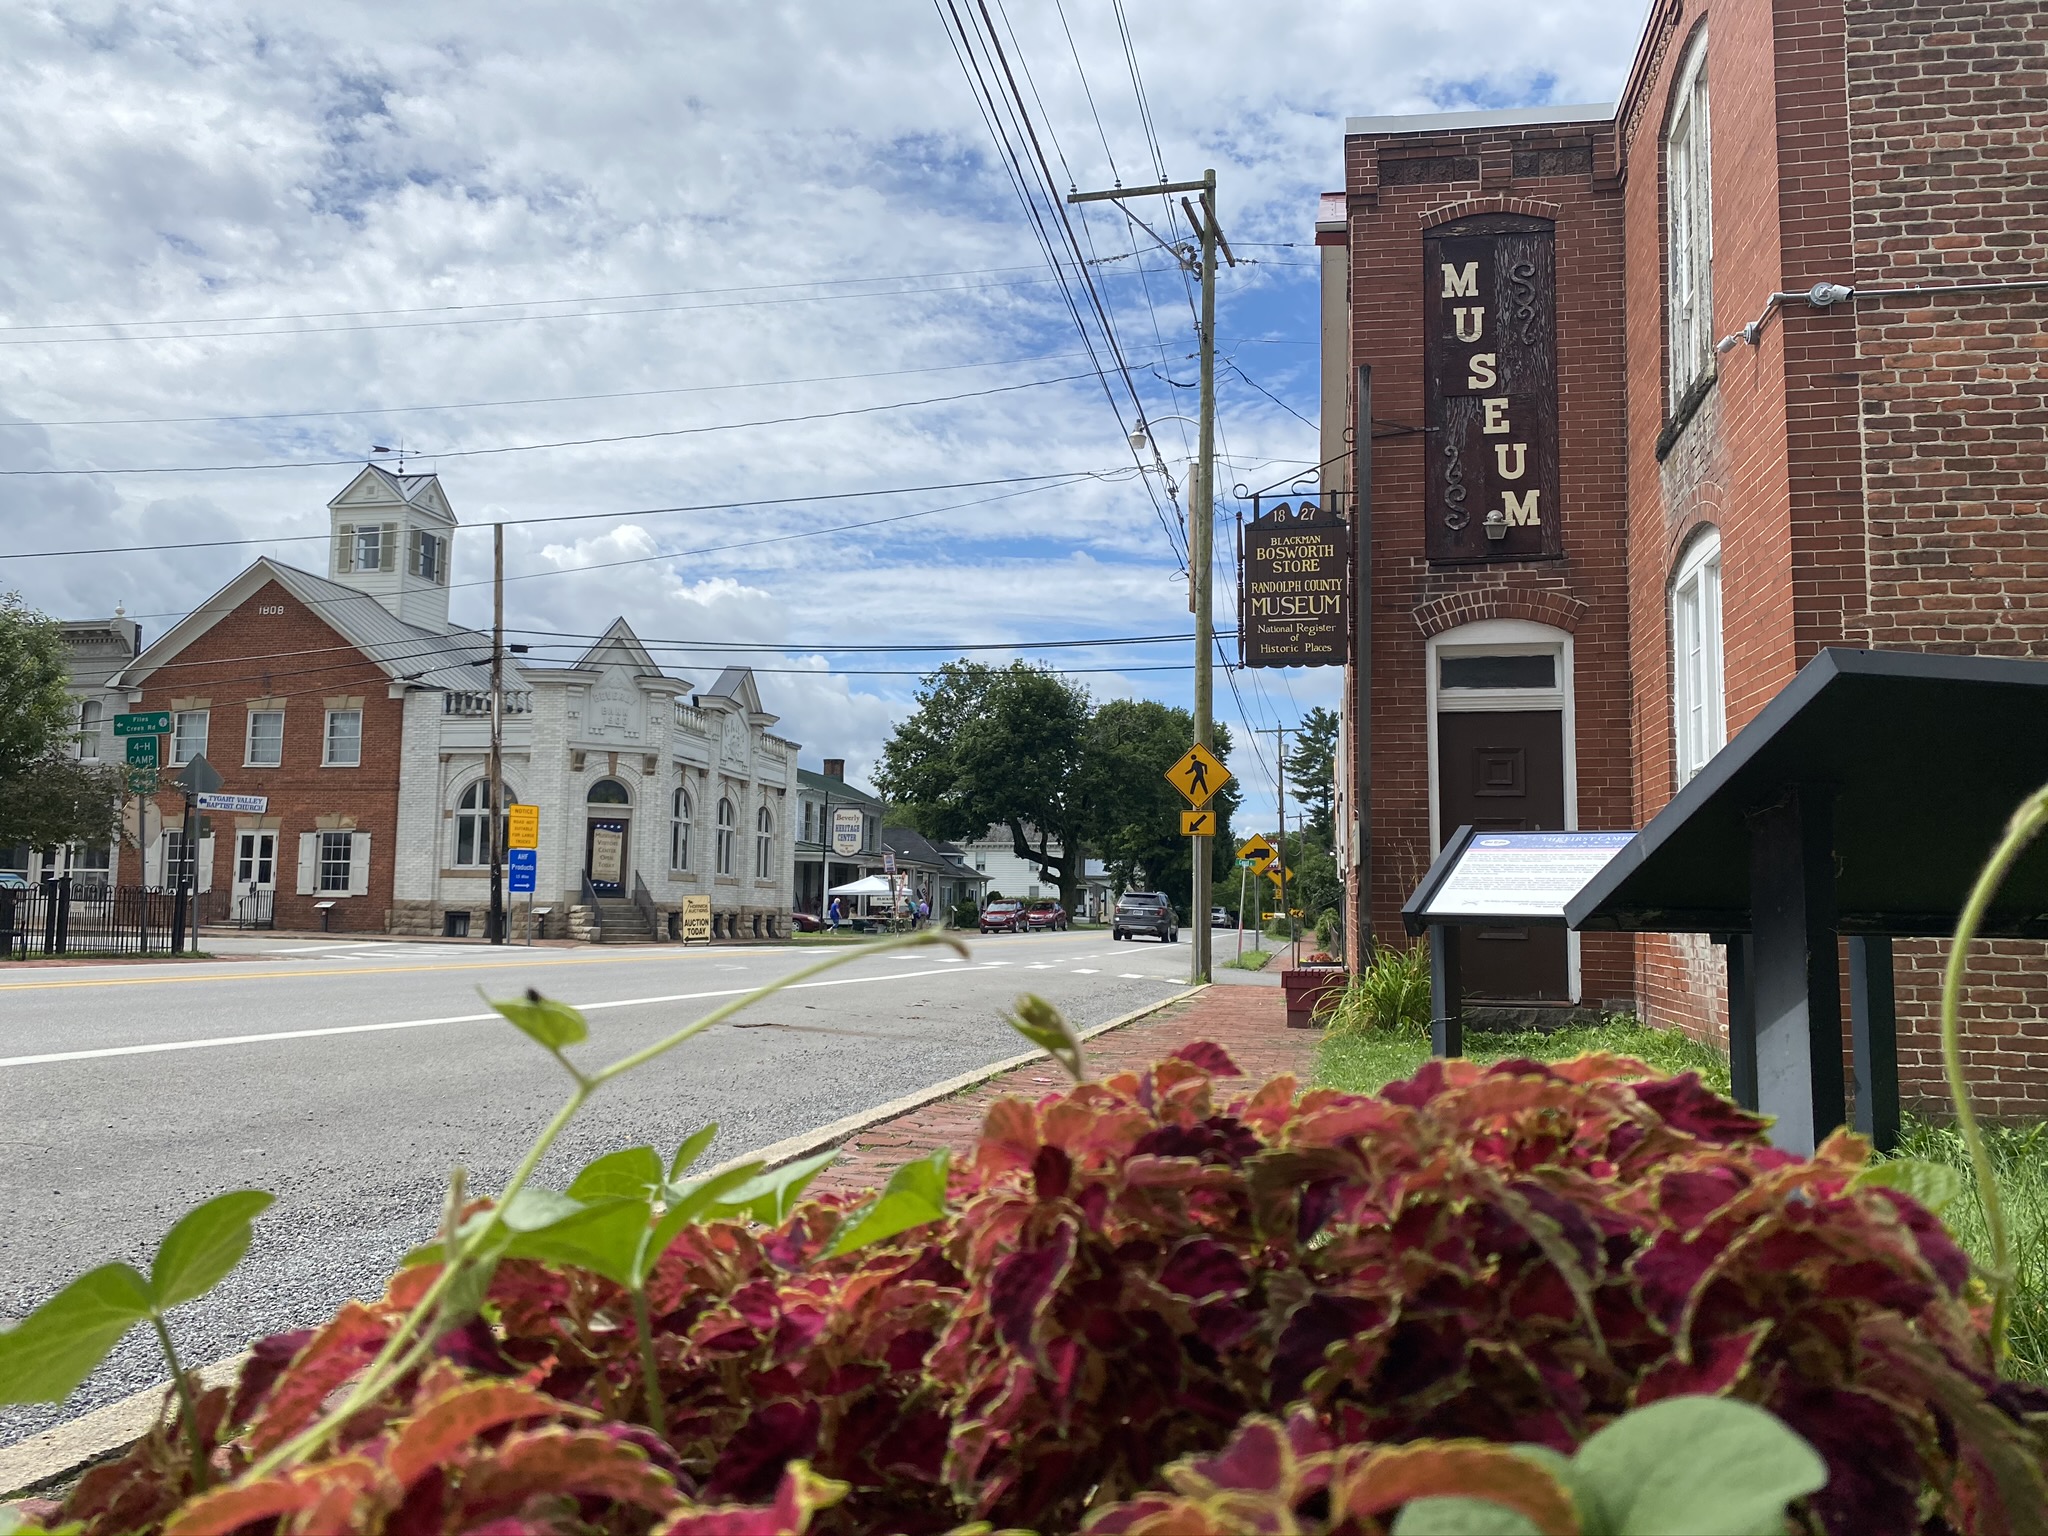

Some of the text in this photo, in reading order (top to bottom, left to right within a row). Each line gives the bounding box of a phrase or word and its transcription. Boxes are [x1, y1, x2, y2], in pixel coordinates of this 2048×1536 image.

[1441, 262, 1541, 527] MUSEUM
[1273, 508, 1316, 523] 18 27
[1270, 535, 1321, 546] BLACKMAN
[1256, 545, 1334, 560] BOSWORTH
[1272, 559, 1320, 573] STORE
[1251, 578, 1343, 594] RANDOLPH COUNTY
[259, 605, 284, 615] 1808
[1251, 594, 1341, 616] MUSEUM
[1257, 623, 1336, 636] National Register
[1290, 634, 1300, 642] of
[1260, 642, 1332, 654] Historic Places
[133, 742, 151, 751] 4-H
[129, 755, 155, 765] CAMP
[236, 796, 263, 805] VALLEY
[206, 802, 264, 812] BAPTIST CHURCH
[836, 814, 860, 823] Beverly
[835, 824, 860, 832] HERITAGE
[837, 833, 857, 842] CENTER
[511, 863, 535, 871] Products
[684, 918, 709, 927] AUCTION
[687, 927, 706, 936] TODAY
